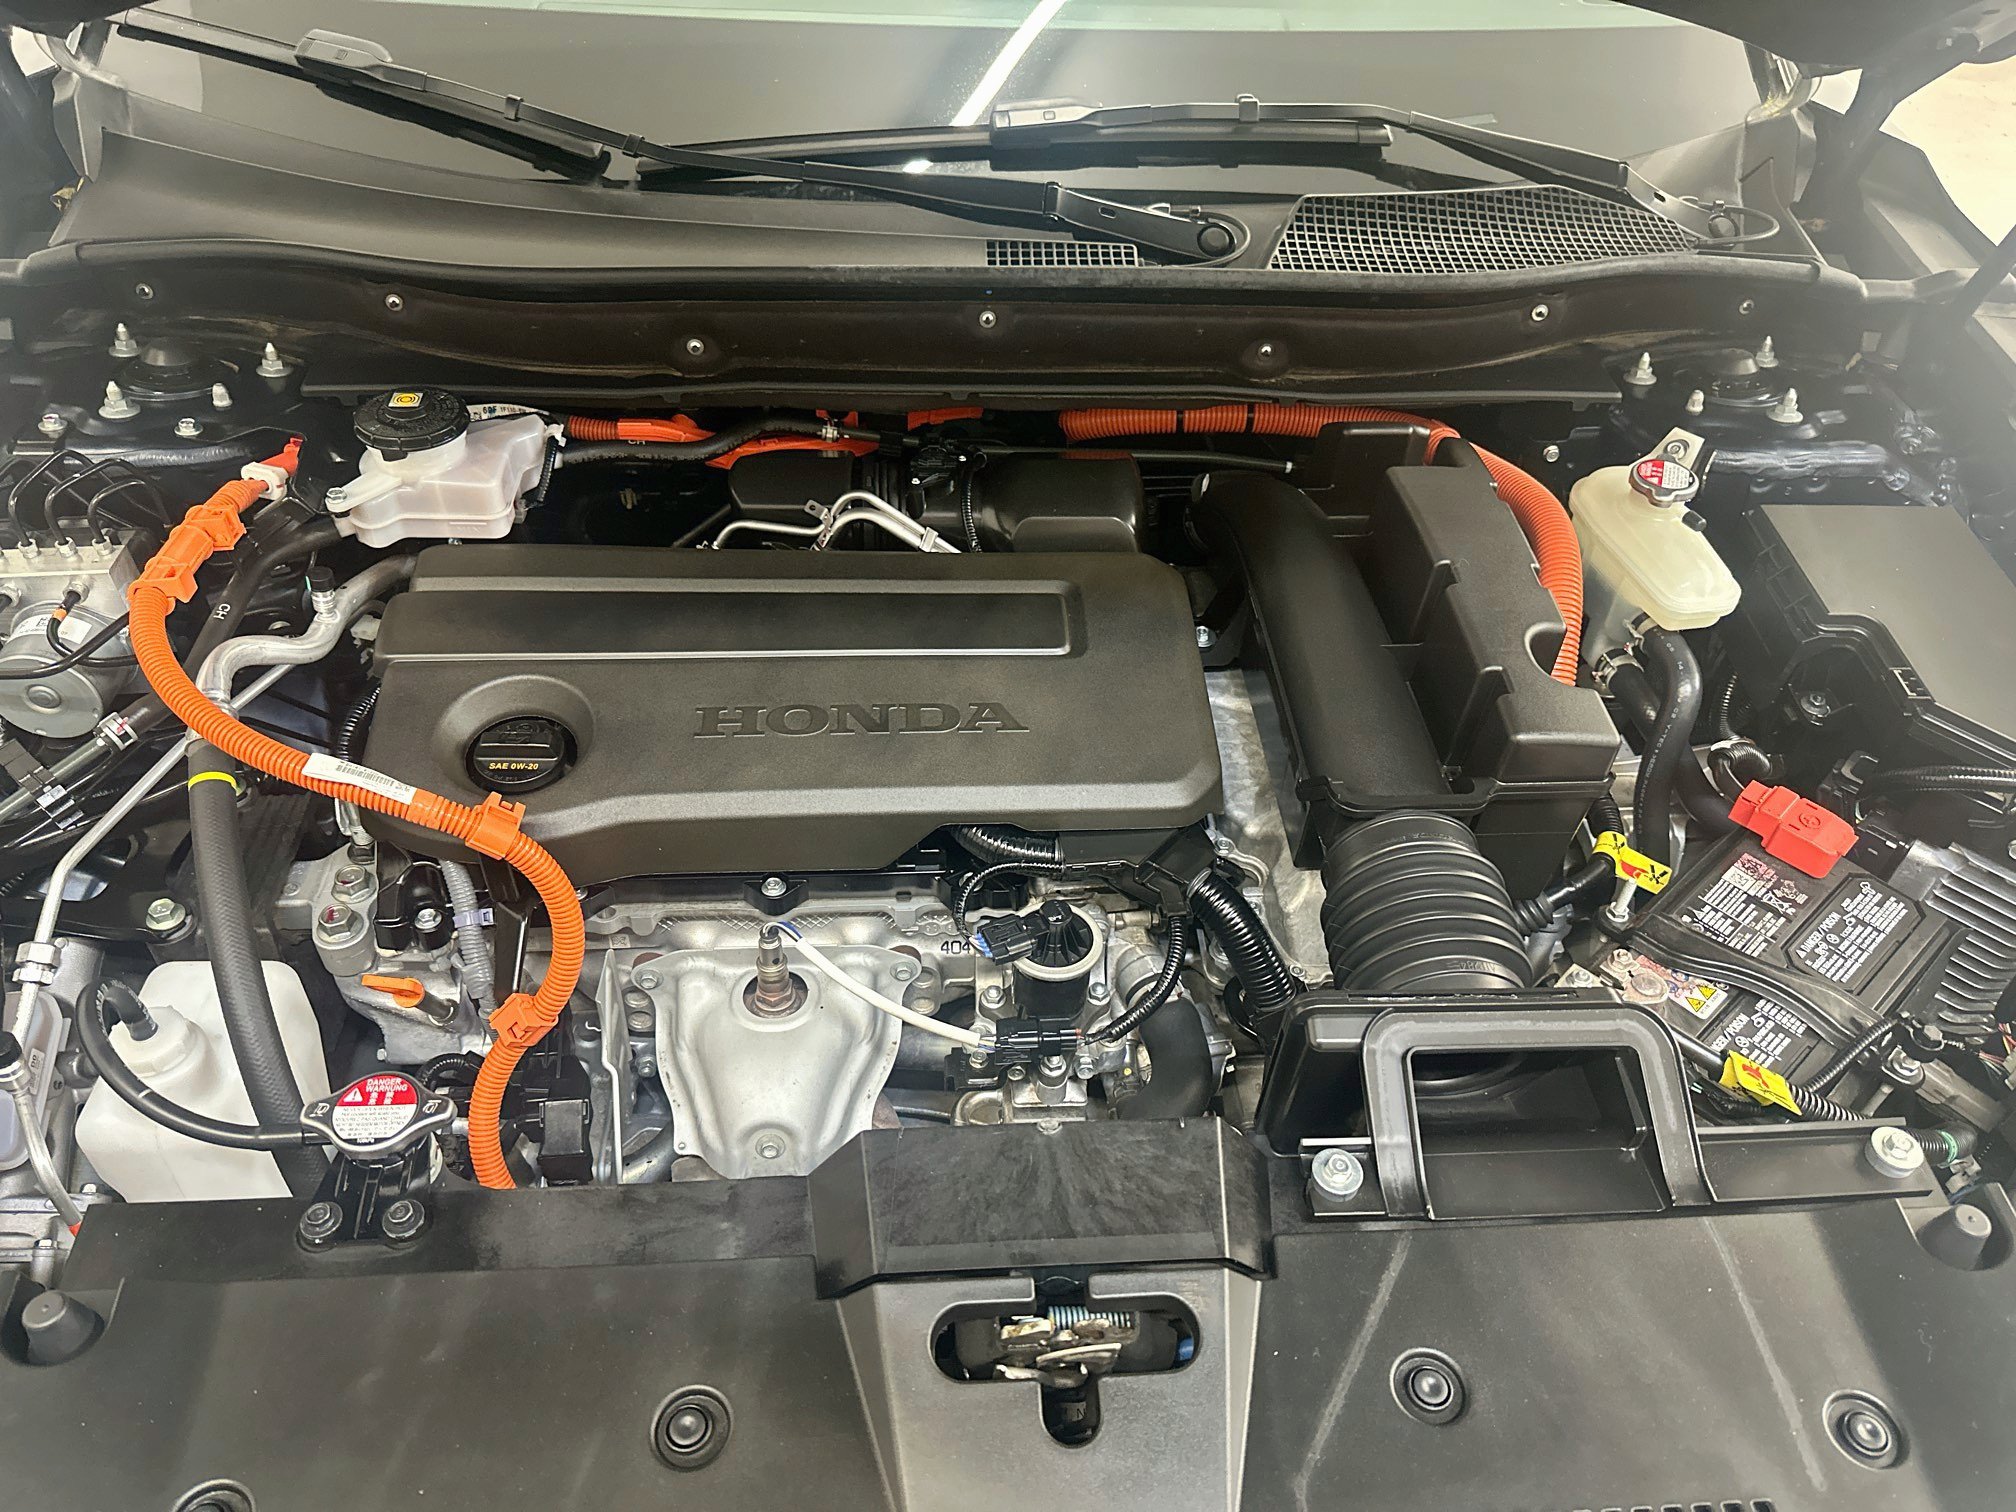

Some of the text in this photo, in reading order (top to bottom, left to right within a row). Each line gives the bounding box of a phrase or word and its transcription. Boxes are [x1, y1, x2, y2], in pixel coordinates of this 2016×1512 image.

[213, 603, 231, 620] CH
[694, 702, 1030, 738] HONDA
[489, 762, 539, 770] SAE 0W-20
[365, 1084, 408, 1092] WARNUNG
